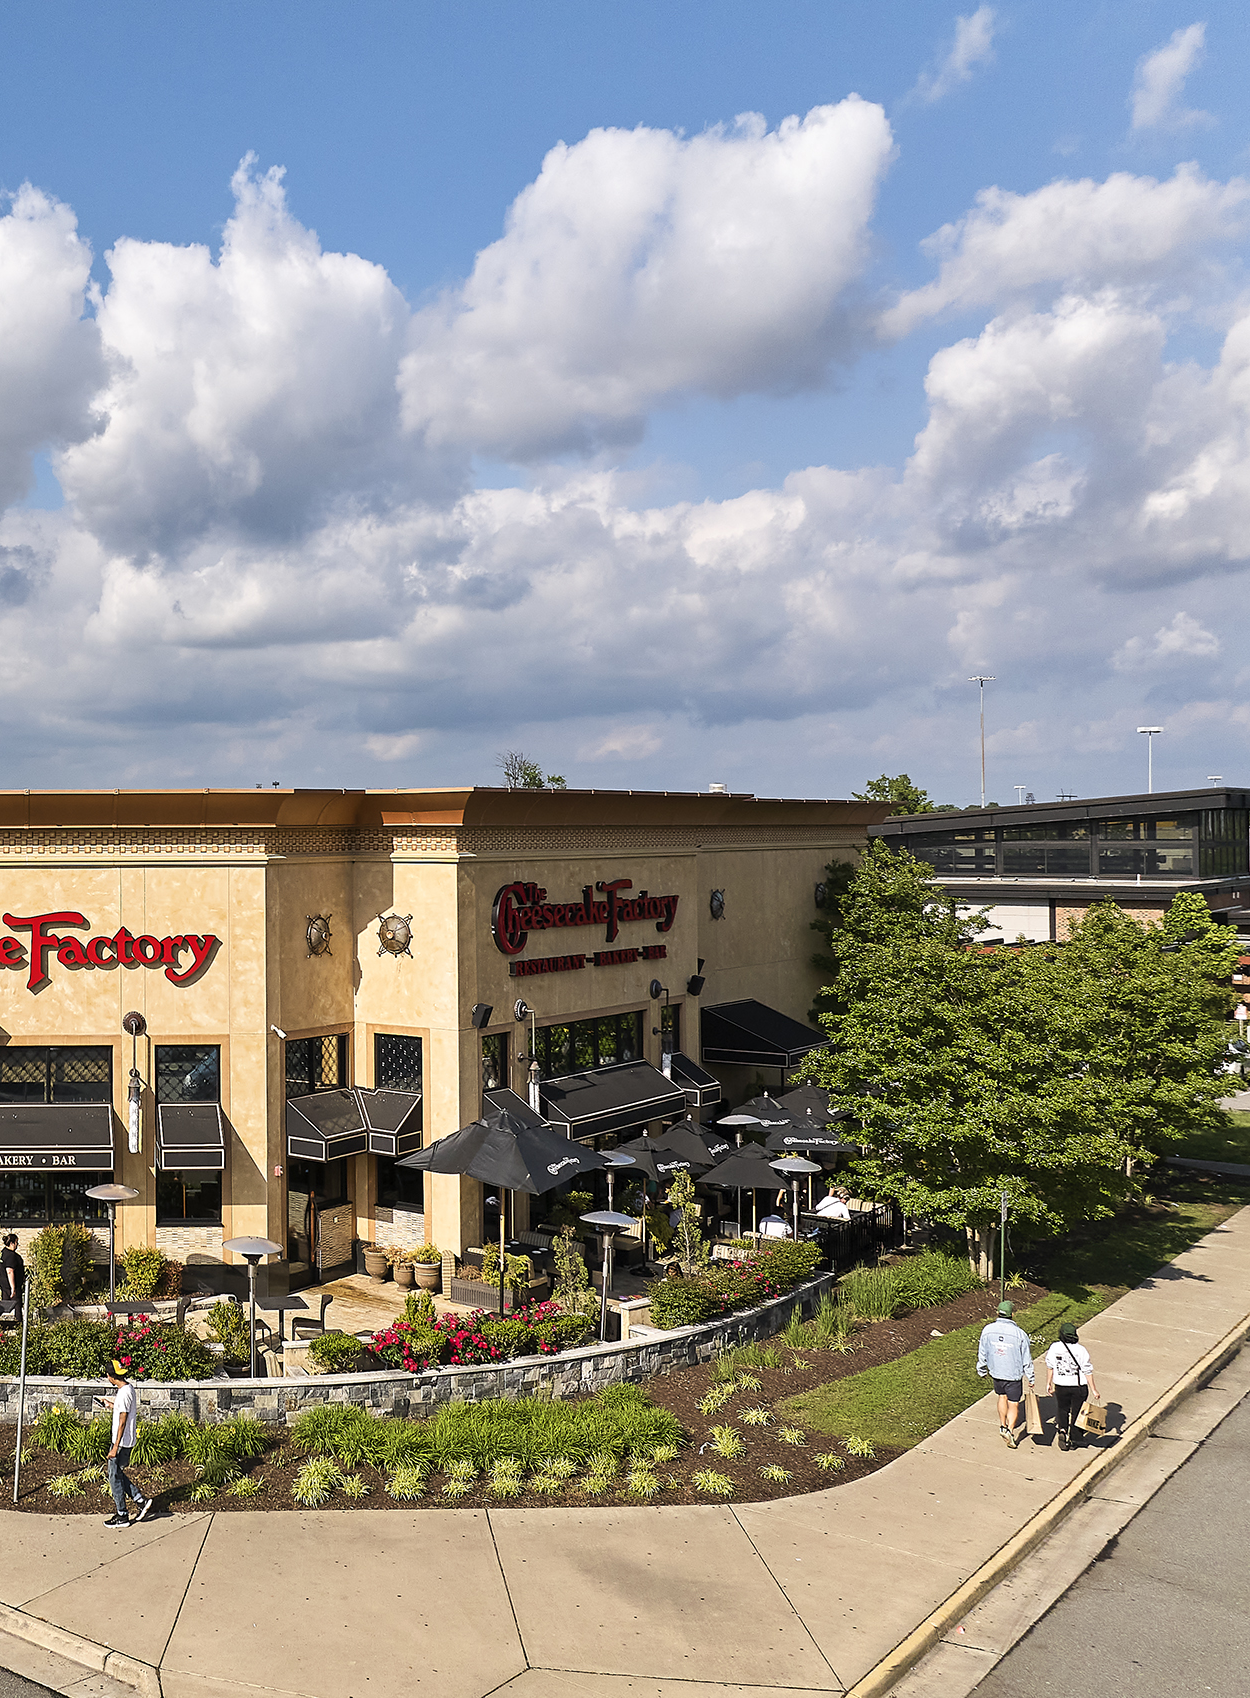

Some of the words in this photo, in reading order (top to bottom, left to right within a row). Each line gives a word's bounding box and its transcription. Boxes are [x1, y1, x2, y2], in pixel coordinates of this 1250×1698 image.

[526, 882, 547, 904] The
[494, 882, 611, 954] Cheesecake
[598, 879, 679, 942] Factory
[2, 911, 218, 991] Factory
[513, 954, 586, 976] RESTAURANT
[598, 948, 639, 965] BAKERY
[647, 945, 667, 960] BAR
[52, 1155, 77, 1166] BAR
